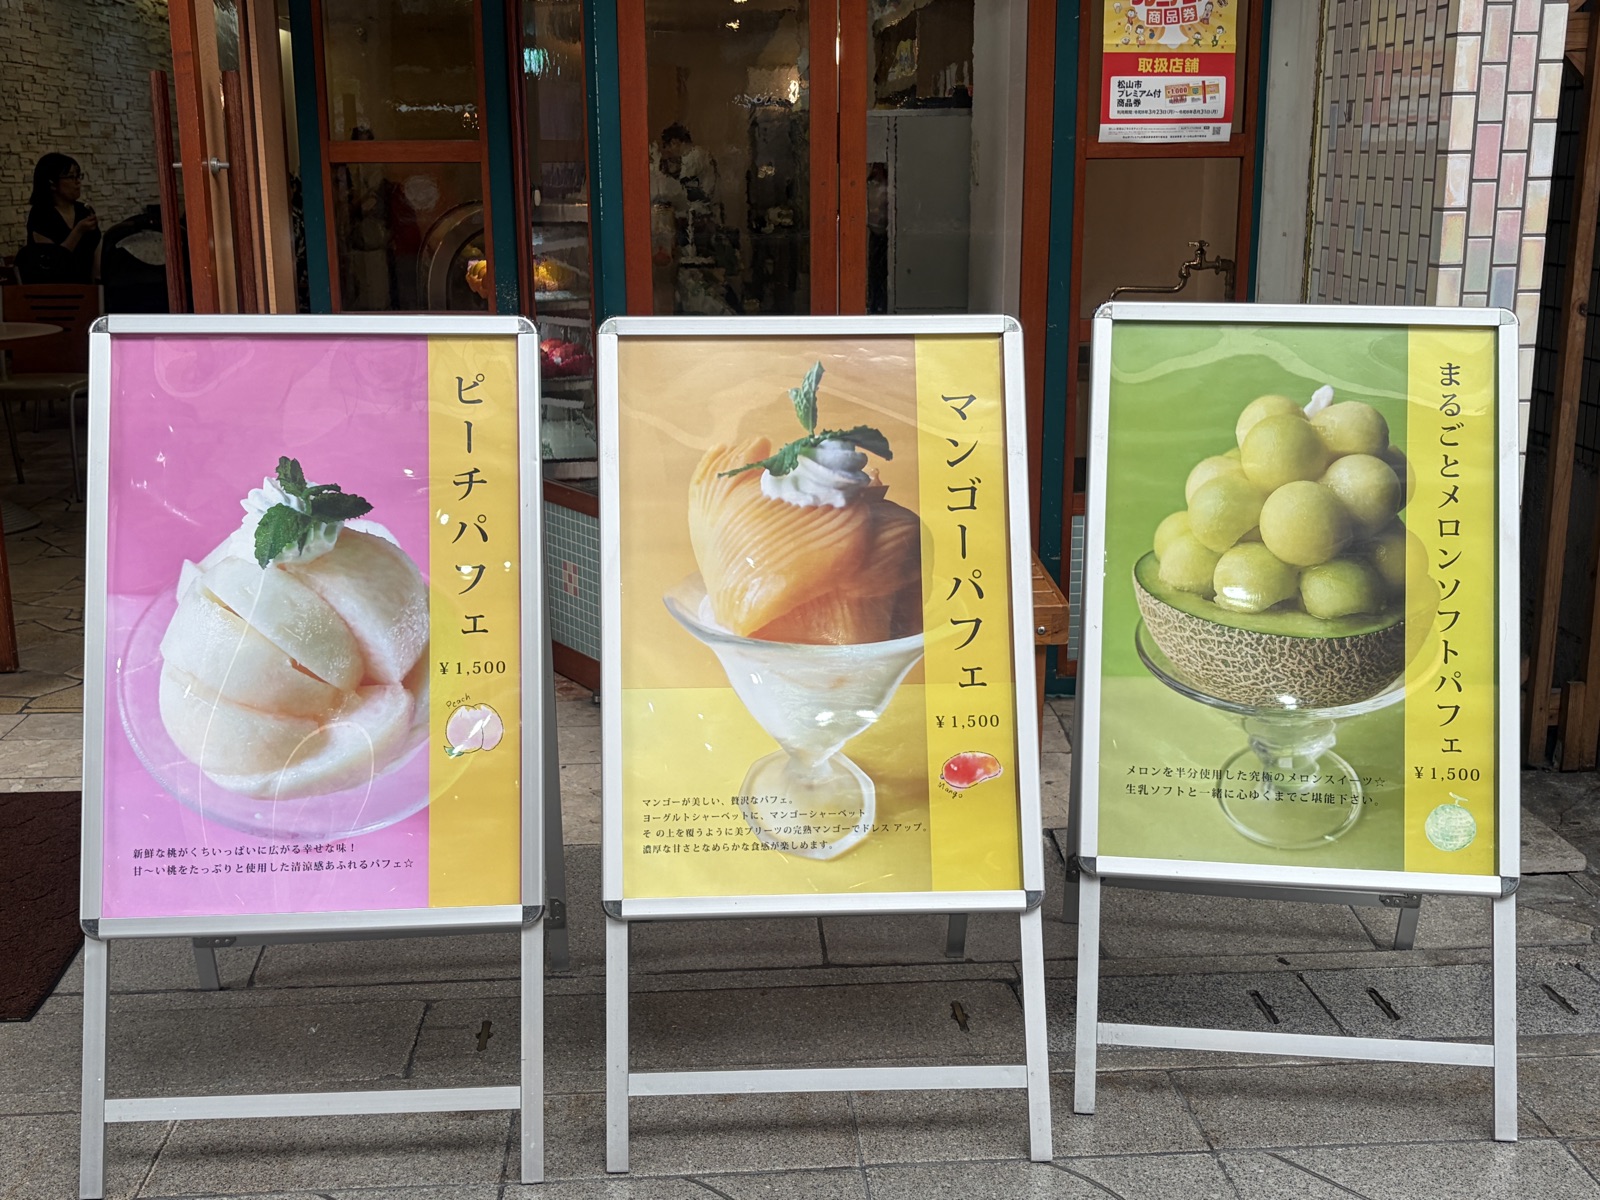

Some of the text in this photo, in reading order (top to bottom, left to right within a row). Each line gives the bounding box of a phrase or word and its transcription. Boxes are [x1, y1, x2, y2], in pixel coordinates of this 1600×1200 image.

[1148, 7, 1196, 24] 商品券
[1137, 57, 1200, 73] 取扱店舗
[1117, 79, 1142, 89] 松山市
[1117, 89, 1162, 98] プレミアム付
[1116, 98, 1142, 108] 商品券
[452, 373, 489, 635] ピーチパフェ
[941, 394, 987, 688] マンゴーパフェ
[1435, 362, 1464, 753] まるごとメロンソフトパフェ
[439, 660, 506, 676] ¥1,500
[935, 714, 1000, 729] ¥1,500
[1414, 766, 1481, 781] ¥1,500
[1125, 783, 1379, 806] 生乳ソフトと一緒に心ゆくまでご堪能下さい。
[133, 843, 356, 859] 新鮮な桃がくちいっぱいに広がる幸せな味!
[642, 840, 833, 854] 濃厚な甘さとなめらかな食感が楽しめます。
